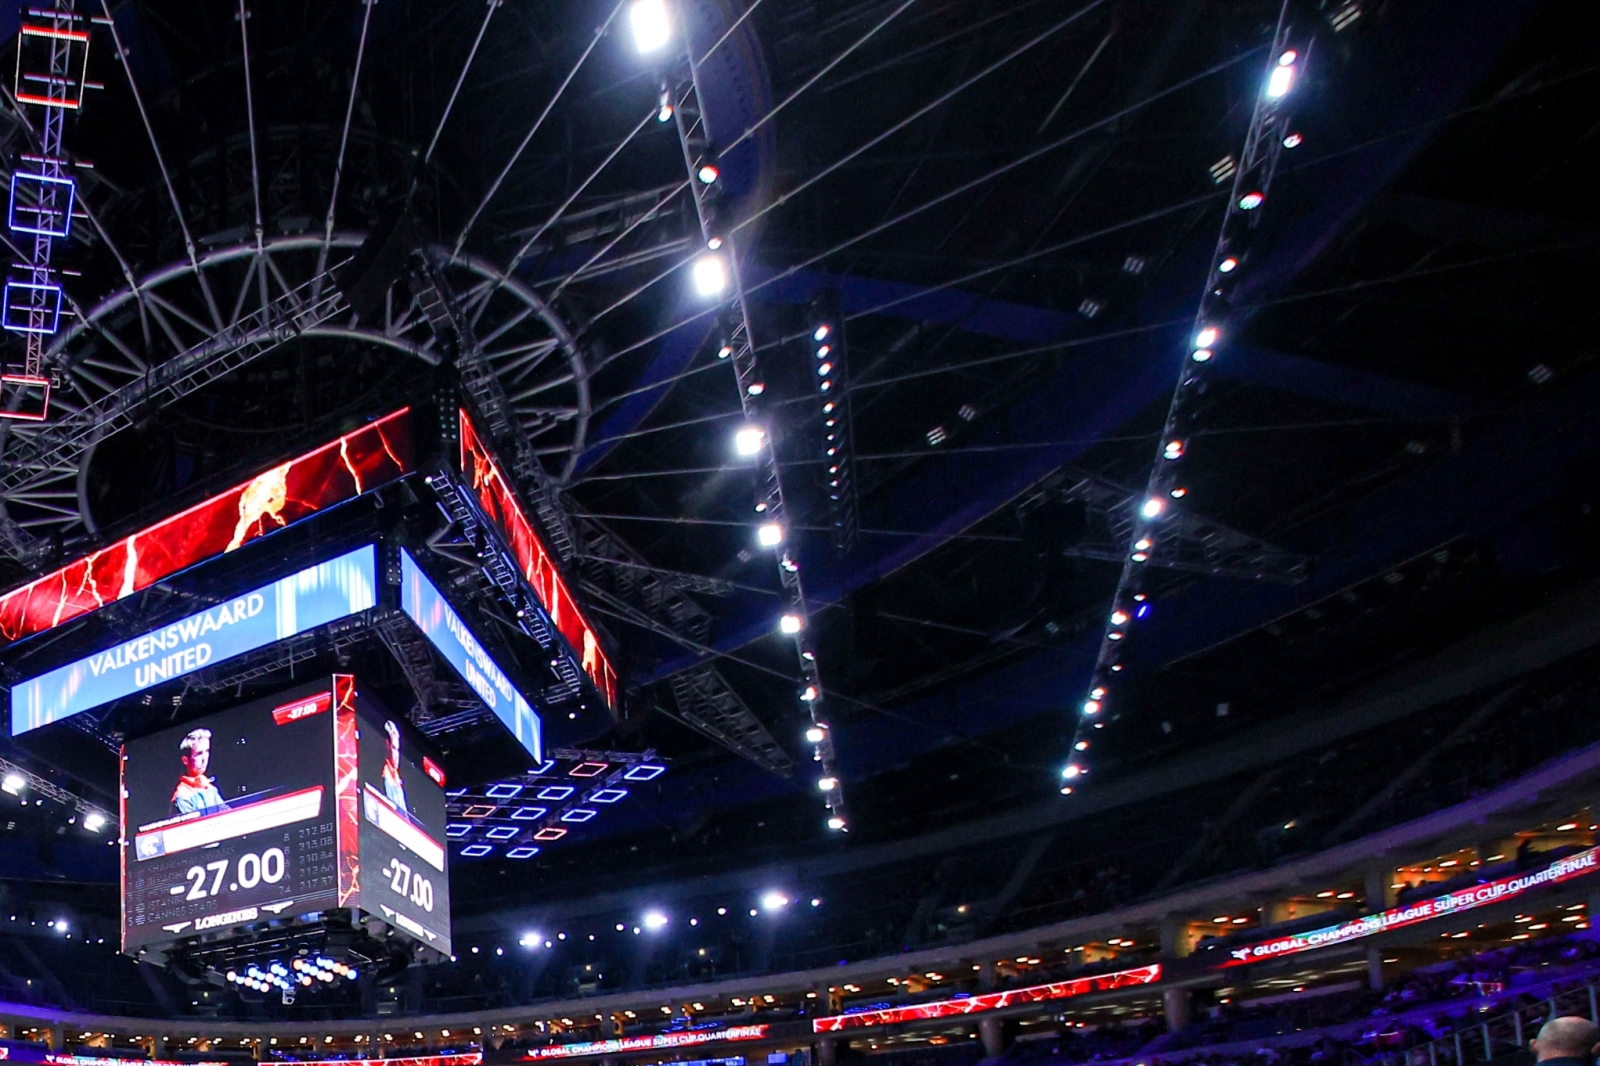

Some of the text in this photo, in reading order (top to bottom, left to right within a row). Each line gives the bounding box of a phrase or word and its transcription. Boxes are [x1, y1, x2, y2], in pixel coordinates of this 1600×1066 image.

[89, 594, 264, 677] VALKENSWAARD
[444, 604, 512, 702] VALKENSWAARD
[135, 643, 212, 687] UNITED
[465, 659, 496, 708] UNITED
[287, 703, 317, 719] -27.00
[170, 848, 285, 901] -27.00
[382, 858, 433, 912] -27.00
[195, 907, 258, 930] LONGINES
[1254, 854, 1596, 956] GLOBAL CHAMPIONS LEAGUE SUPER CUP QUARTERFINAL
[56, 1057, 79, 1065] GLOBAL
[80, 1058, 118, 1066] CHAMPIONS
[541, 1029, 761, 1059] GLOBAL CHAMPIONS LEAGUE SUPER CUP QUARTERFINAL
